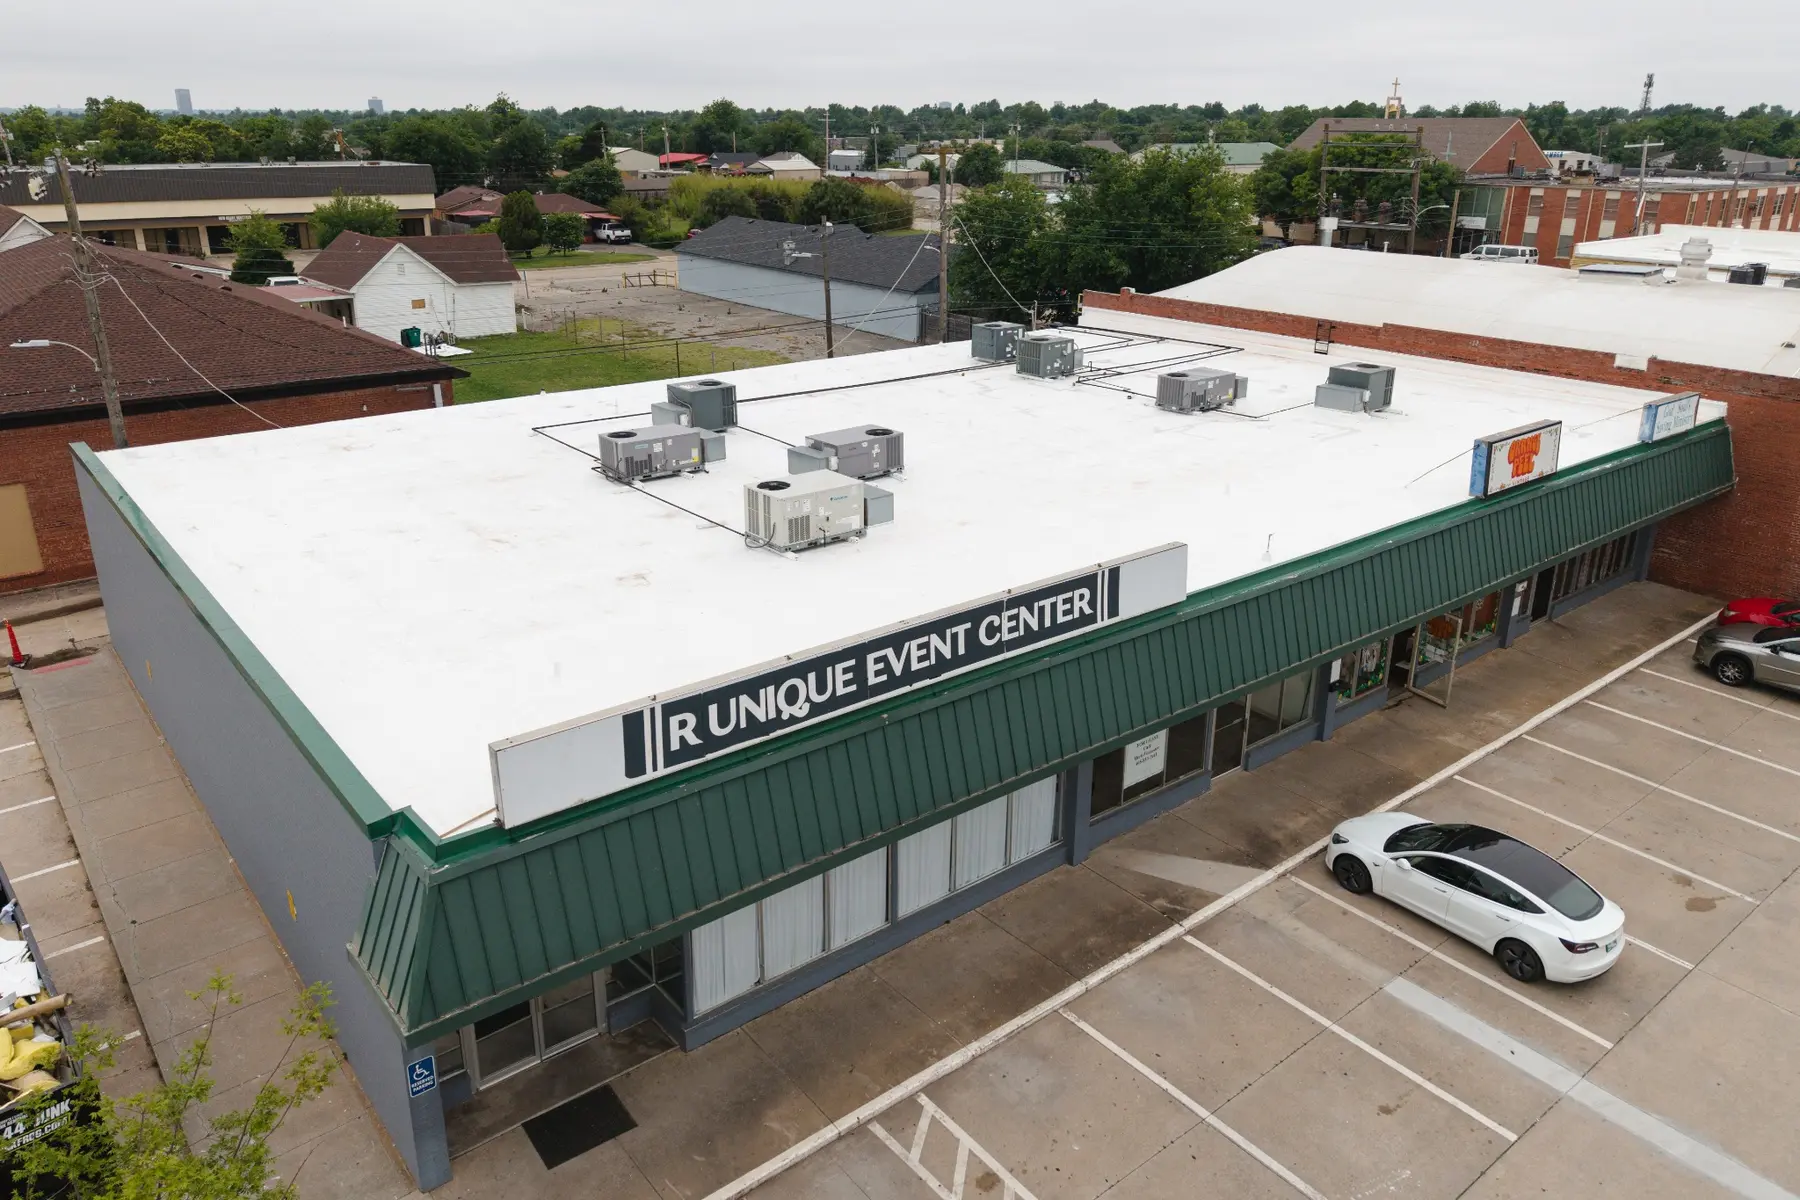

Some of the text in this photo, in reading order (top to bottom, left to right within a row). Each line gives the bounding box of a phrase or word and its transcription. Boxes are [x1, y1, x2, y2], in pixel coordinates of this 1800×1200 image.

[1511, 453, 1535, 478] PEEL
[669, 587, 1093, 751] R UNIQUE EVENT CENTER
[411, 1075, 434, 1088] RESERVED
[413, 1080, 434, 1093] PARKING
